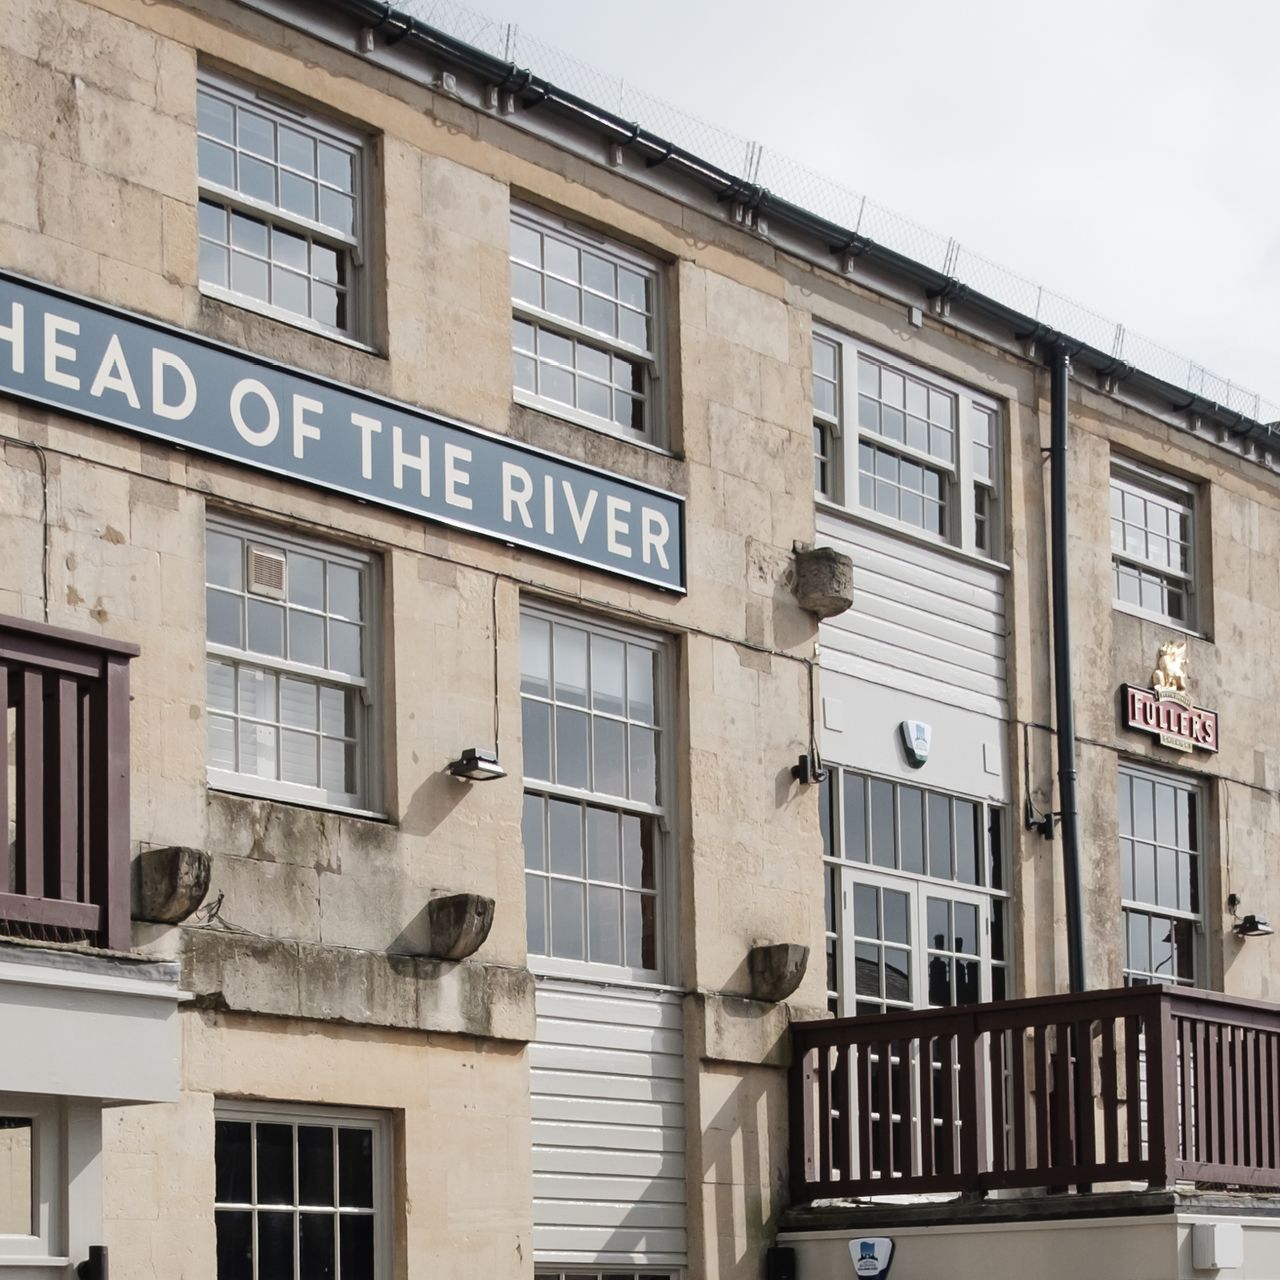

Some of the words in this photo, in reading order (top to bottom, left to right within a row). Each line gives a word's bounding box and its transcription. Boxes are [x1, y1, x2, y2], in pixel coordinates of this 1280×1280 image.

[229, 377, 325, 460] OF
[350, 411, 474, 512] THE
[501, 460, 671, 570] RIVER
[1133, 692, 1214, 743] FULLER'S
